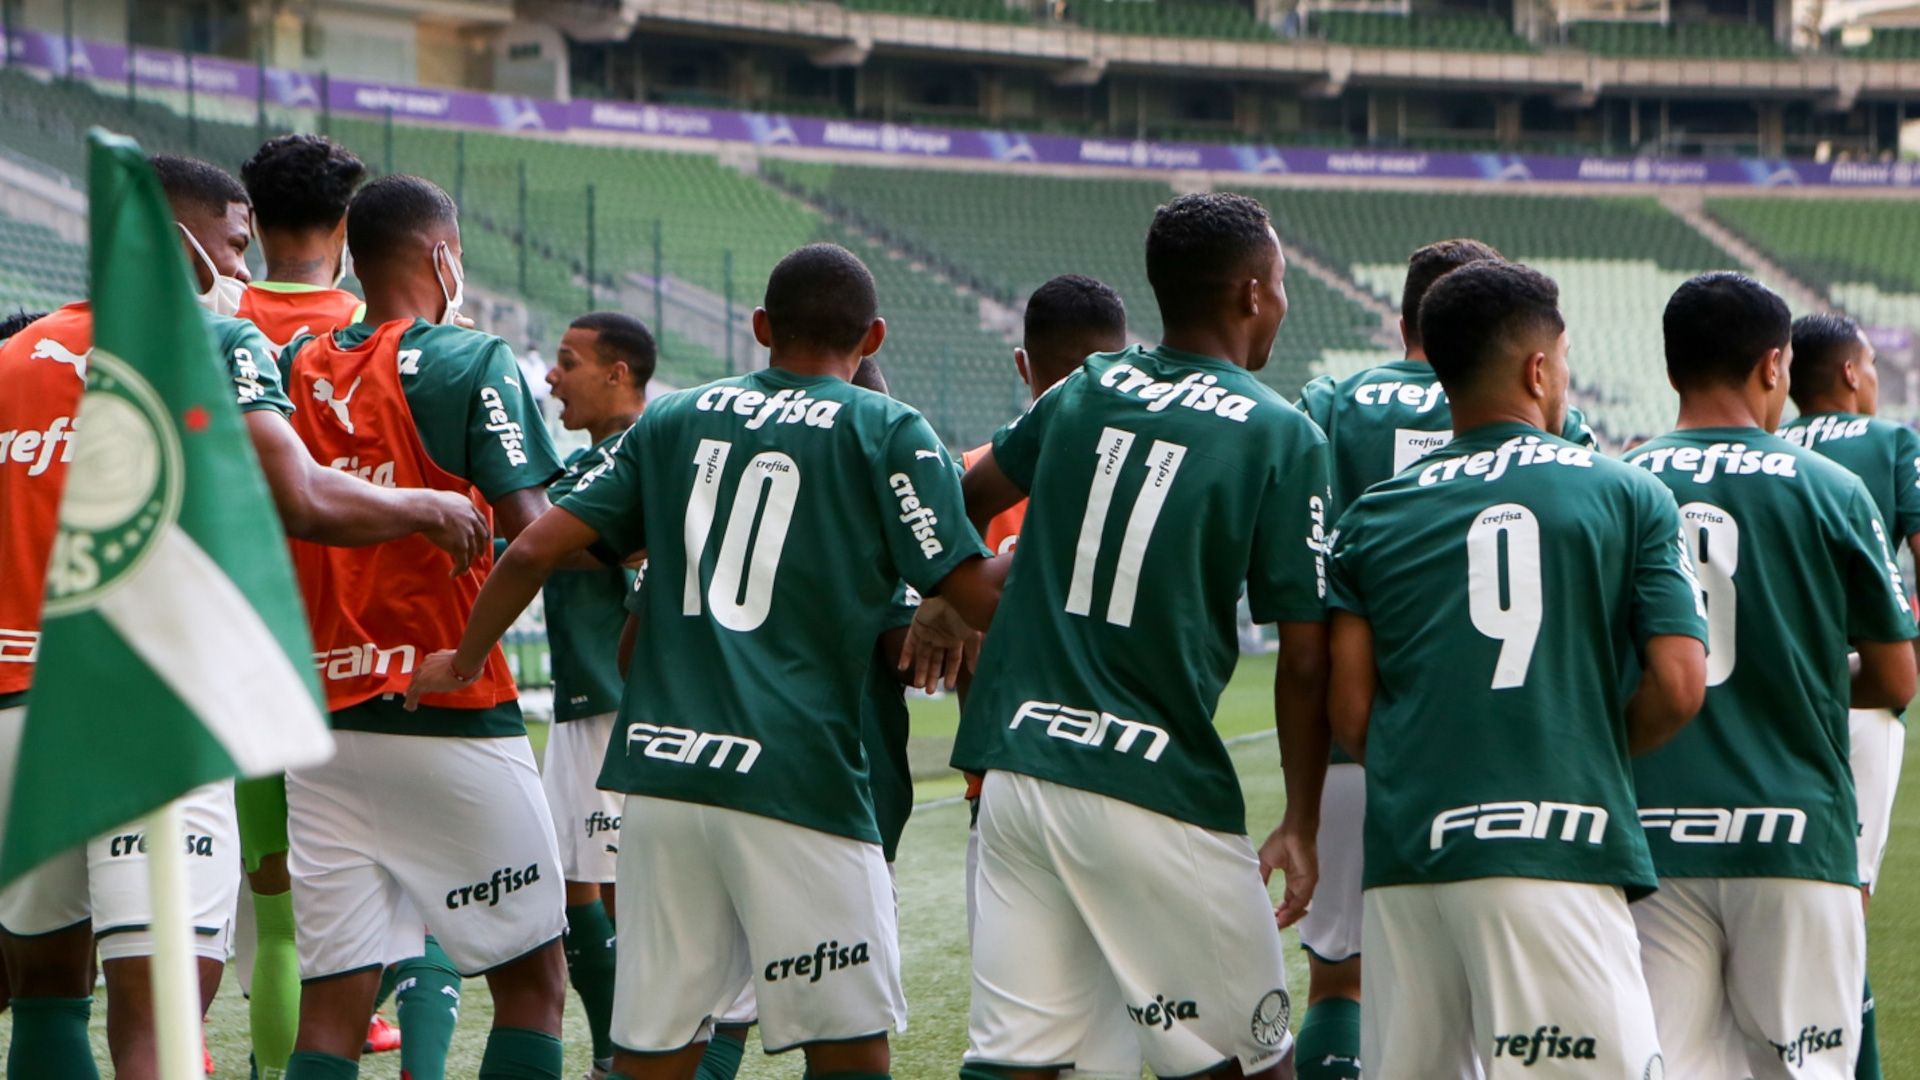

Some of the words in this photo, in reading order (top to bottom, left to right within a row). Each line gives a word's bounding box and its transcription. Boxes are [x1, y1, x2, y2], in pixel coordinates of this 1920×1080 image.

[696, 386, 842, 430] crefisa
[1100, 364, 1258, 423] crefisa
[1354, 381, 1450, 413] cref
[0, 416, 81, 476] refi
[480, 386, 528, 467] crefisa
[1408, 436, 1444, 449] crefisa
[1773, 415, 1871, 451] refisa
[705, 447, 721, 484] crefisa
[755, 459, 790, 474] crefisa
[1104, 437, 1124, 475] crefisa
[1154, 450, 1175, 488] crefisa
[1418, 436, 1593, 487] crefisa
[682, 438, 801, 632] 10
[889, 472, 944, 560] crefisa
[1064, 426, 1188, 628] 11
[1481, 510, 1523, 526] crefisa
[1684, 510, 1725, 524] crefisa
[1466, 502, 1544, 690] 9
[445, 862, 541, 910] crefisa
[764, 940, 871, 983] crefisa
[1494, 1025, 1597, 1067] refisa
